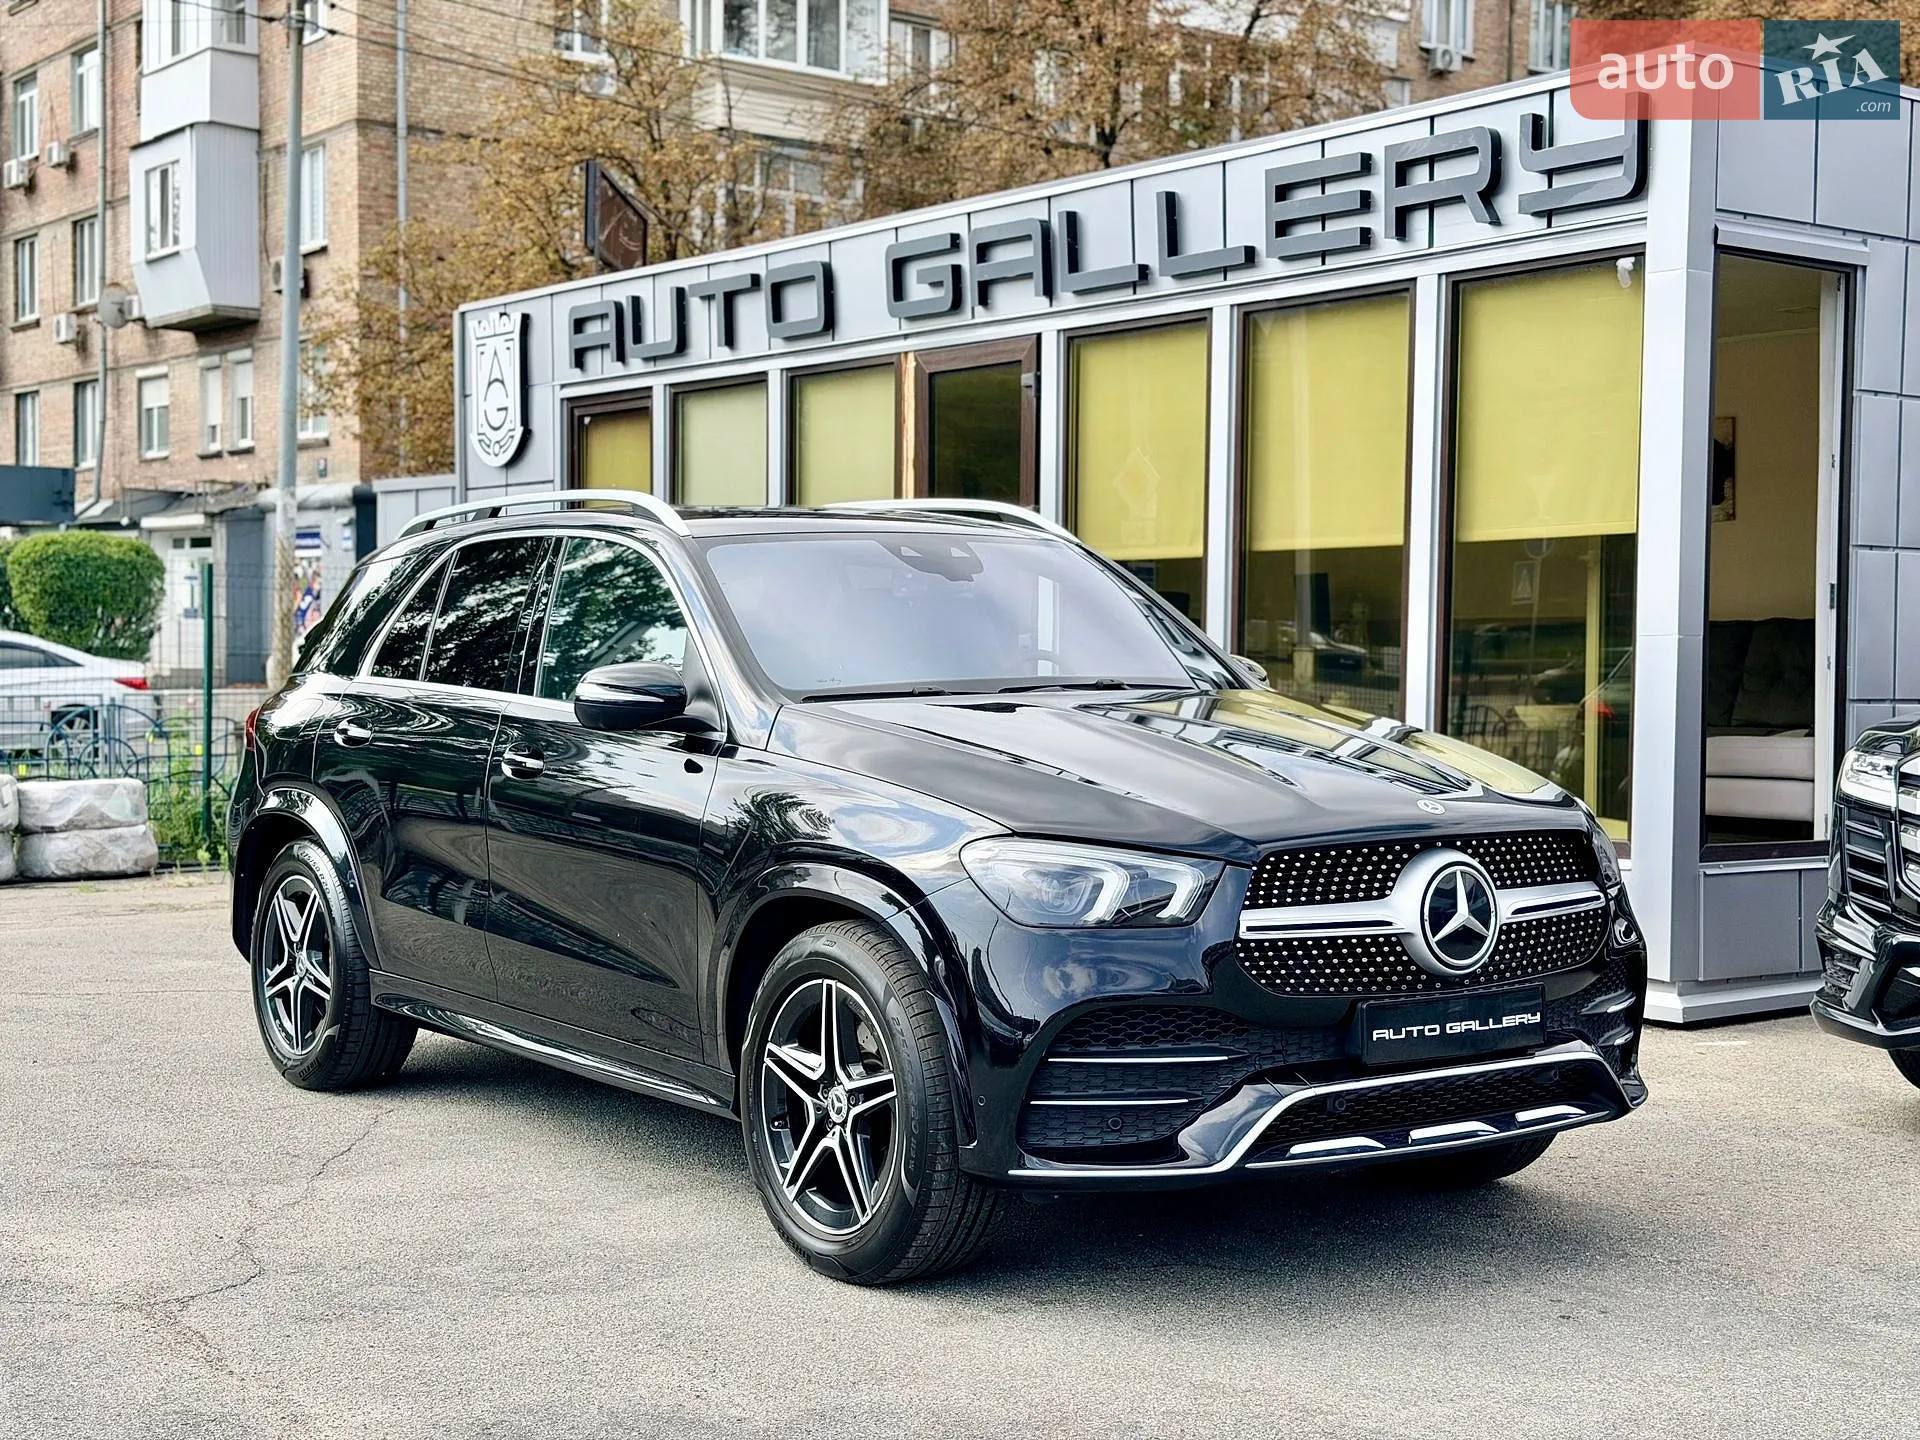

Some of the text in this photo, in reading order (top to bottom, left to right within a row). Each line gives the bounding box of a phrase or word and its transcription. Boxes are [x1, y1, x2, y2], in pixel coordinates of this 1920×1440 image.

[569, 91, 1649, 371] AUTO GALLERY
[1373, 1012, 1541, 1042] AUTO GALLERY
